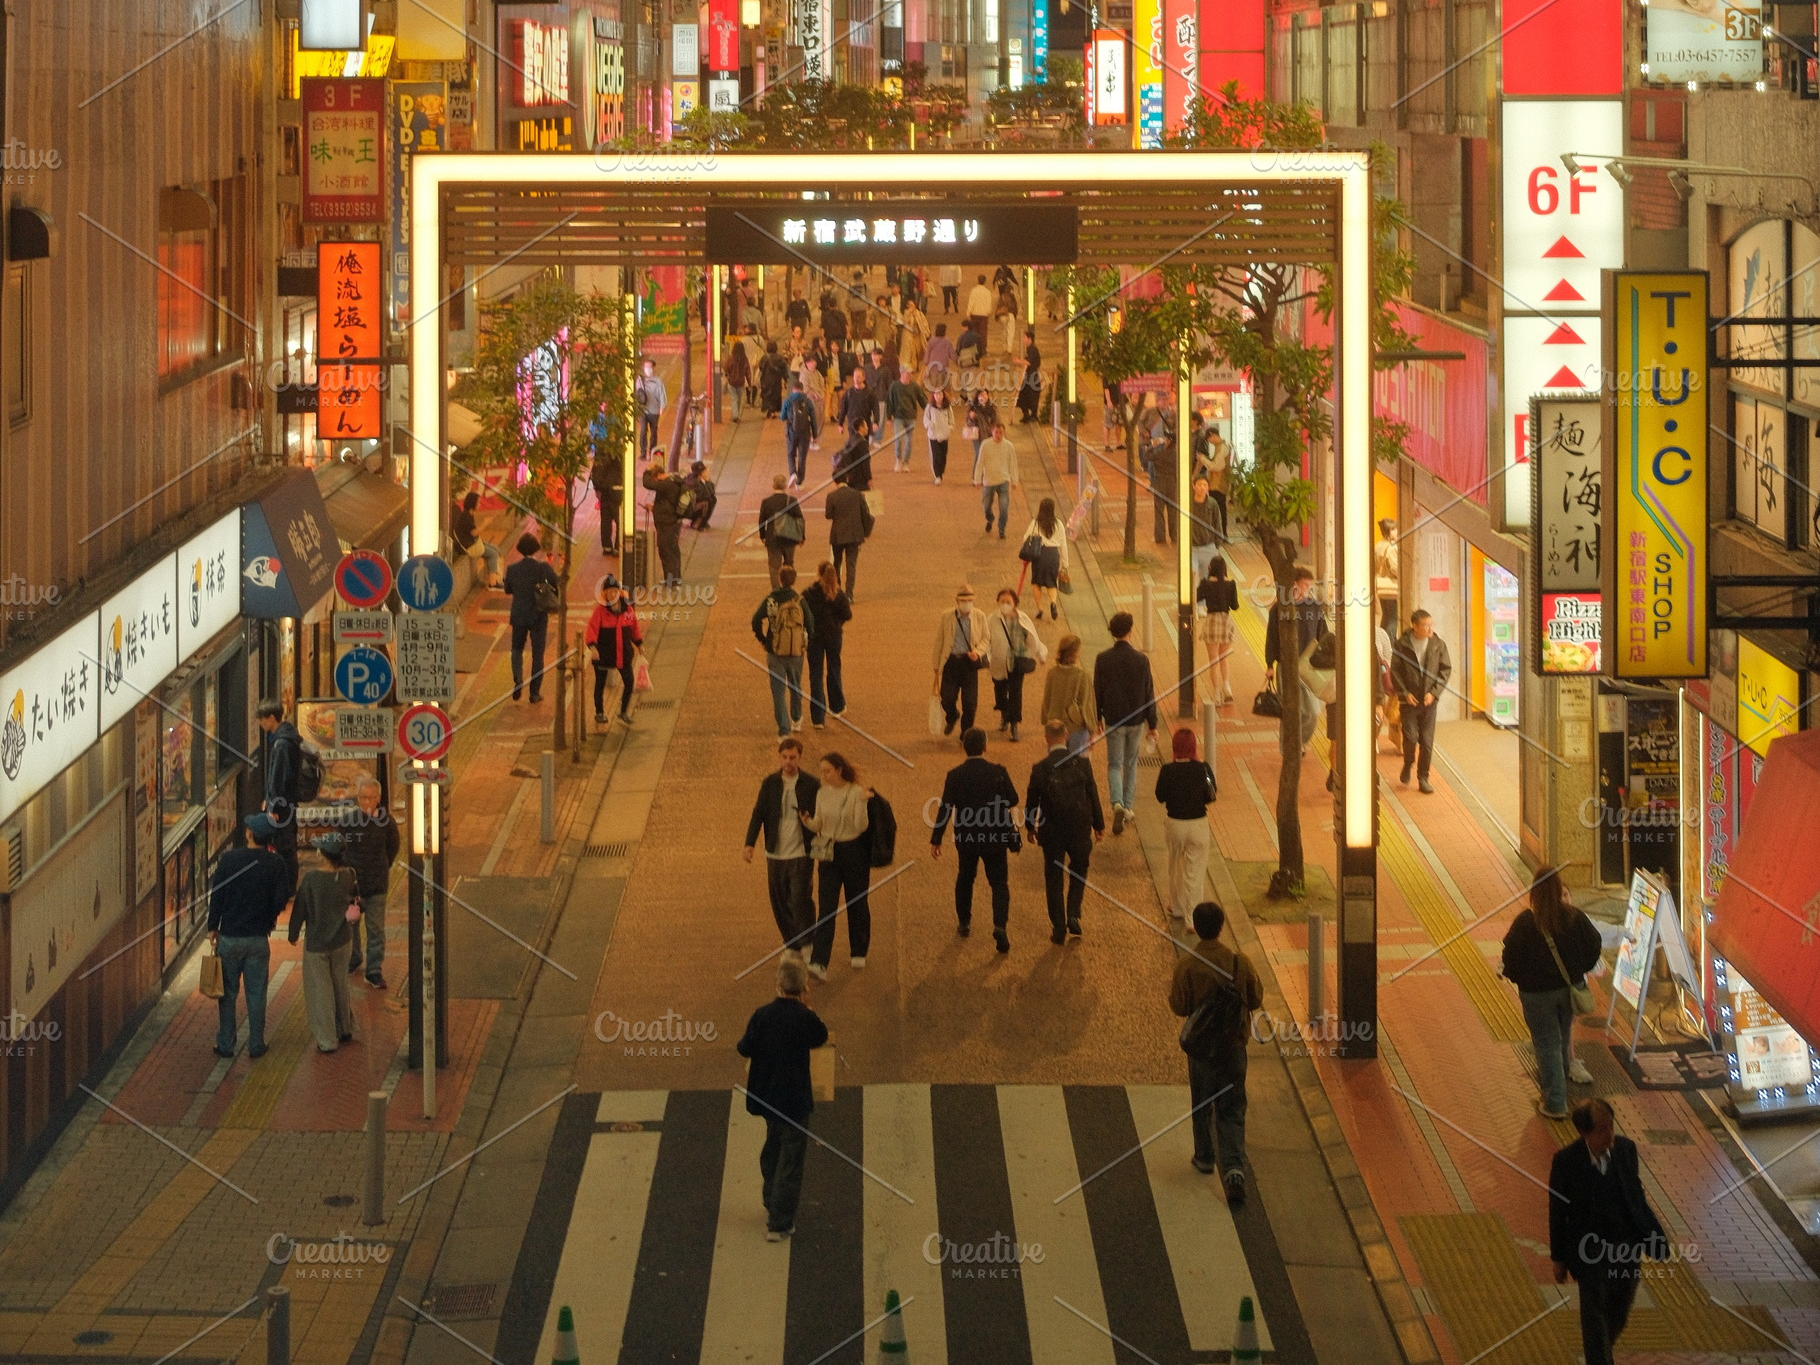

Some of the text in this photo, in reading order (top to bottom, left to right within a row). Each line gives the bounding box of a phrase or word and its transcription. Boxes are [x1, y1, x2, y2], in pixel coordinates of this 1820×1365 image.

[1726, 10, 1759, 40] 3F
[312, 116, 376, 132] 台湾料理
[1528, 166, 1598, 216] 6F
[205, 549, 226, 602] 抹茶
[1629, 531, 1647, 664] 新宿駅東南口店
[1653, 552, 1673, 640] SHOP
[124, 592, 171, 670] 焼きいも
[31, 658, 91, 744] たい焼き
[347, 662, 370, 699] P
[411, 721, 442, 746] 30
